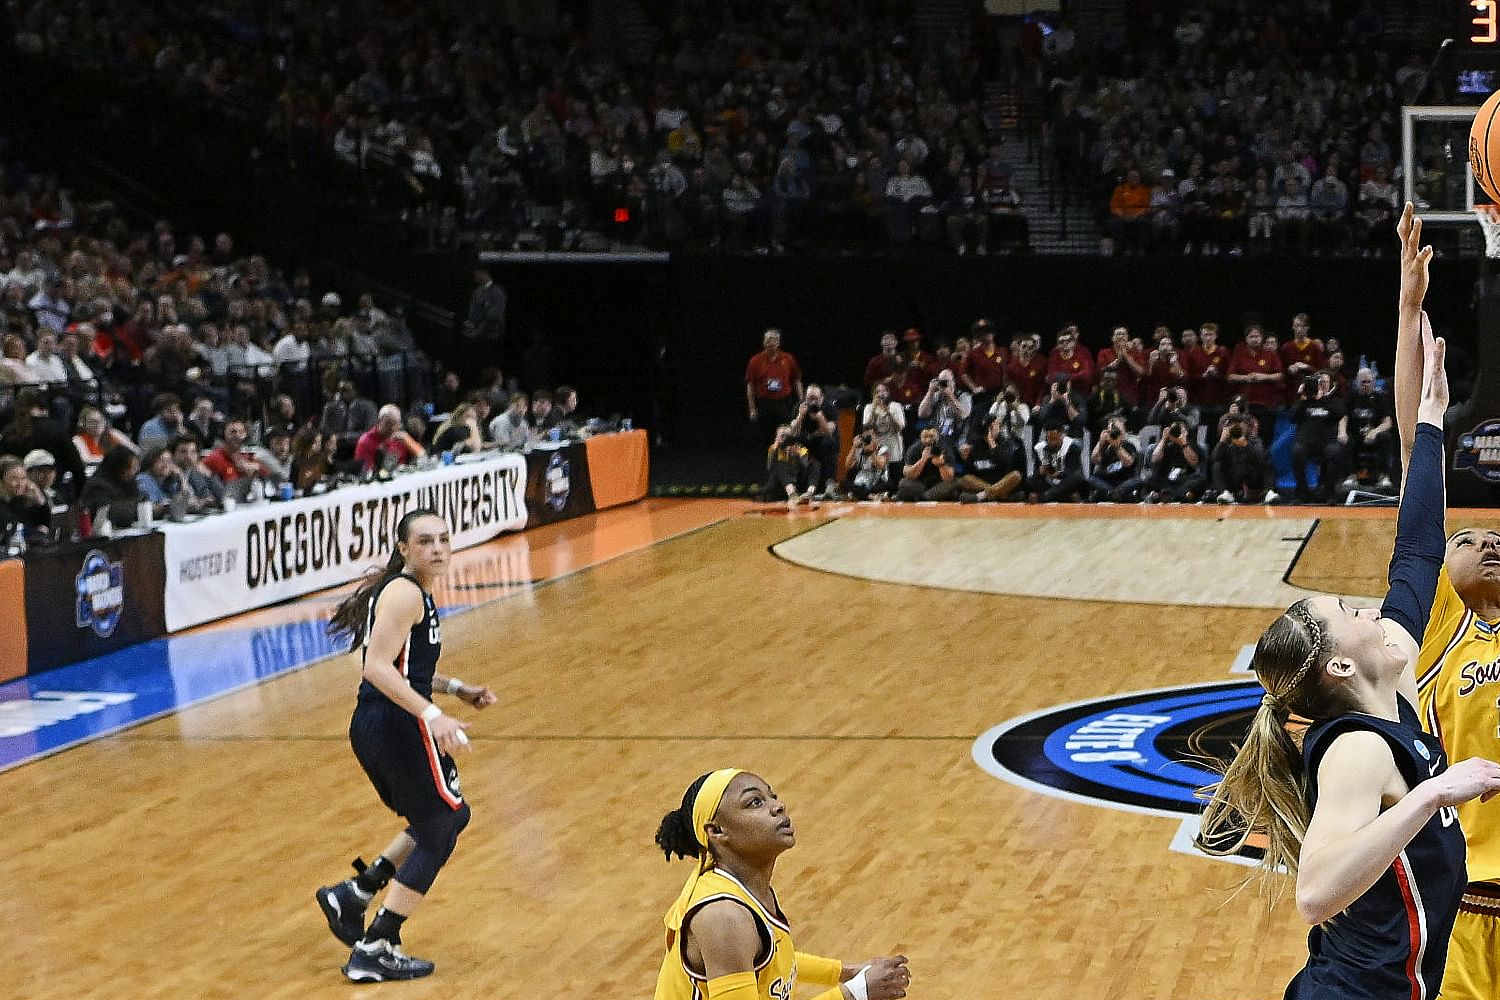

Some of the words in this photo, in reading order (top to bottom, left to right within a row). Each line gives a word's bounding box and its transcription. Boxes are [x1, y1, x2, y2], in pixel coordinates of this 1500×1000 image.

[179, 552, 224, 583] HOSTED
[225, 549, 238, 574] BY
[246, 505, 342, 589] OREGON
